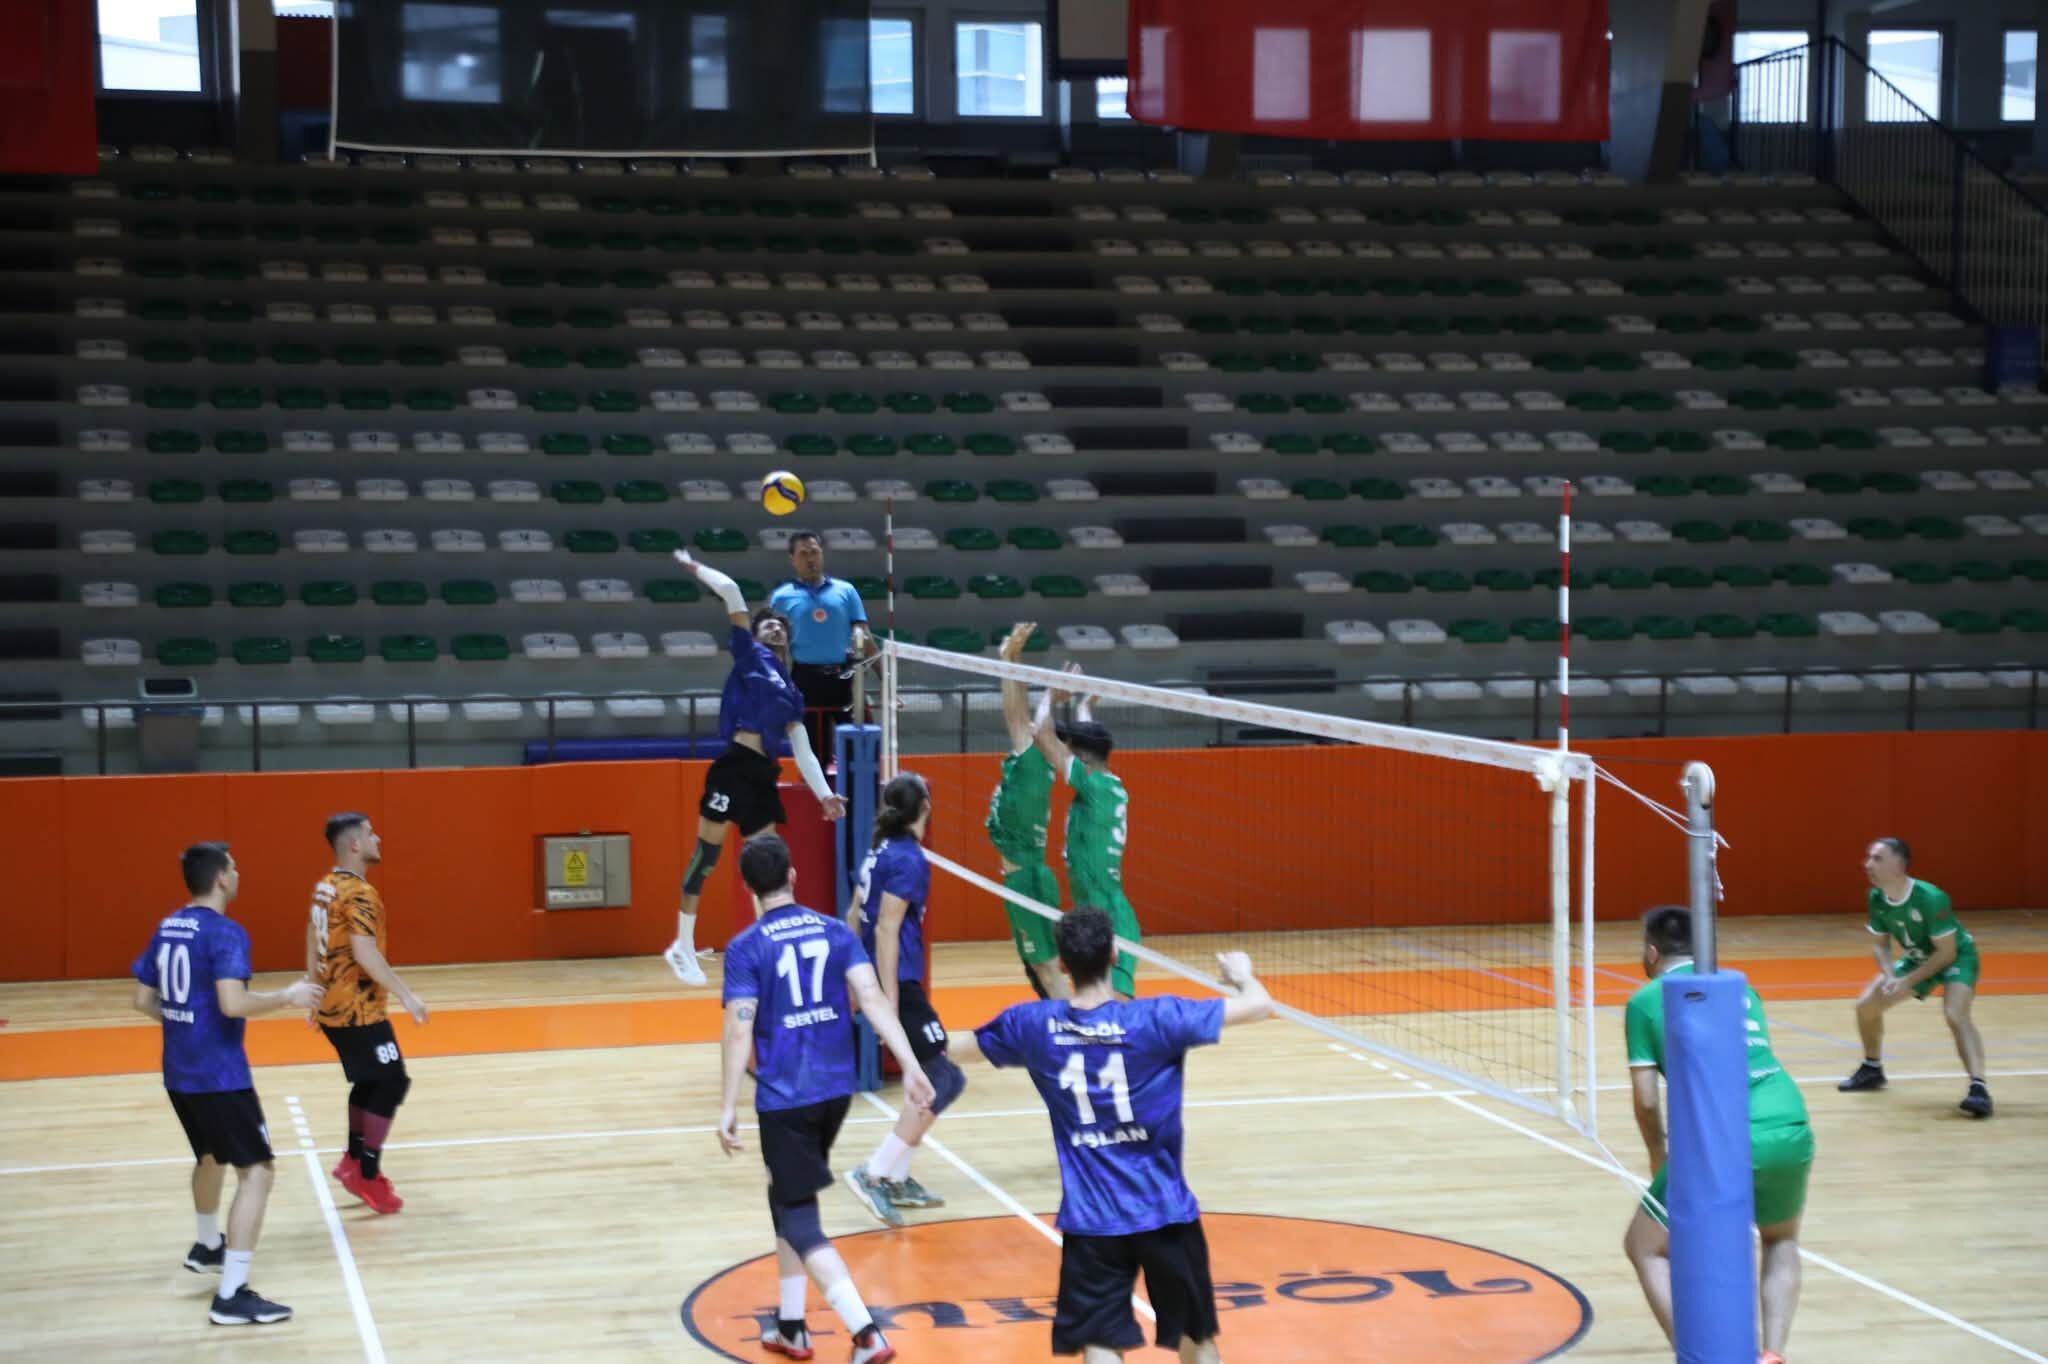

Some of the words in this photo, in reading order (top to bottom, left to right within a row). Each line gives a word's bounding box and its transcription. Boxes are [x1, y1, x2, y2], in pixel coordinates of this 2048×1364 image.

[708, 792, 731, 813] 23
[157, 942, 192, 1004] 10
[776, 938, 830, 1007] 17
[922, 1020, 945, 1044] 15
[1058, 1051, 1135, 1125] 11
